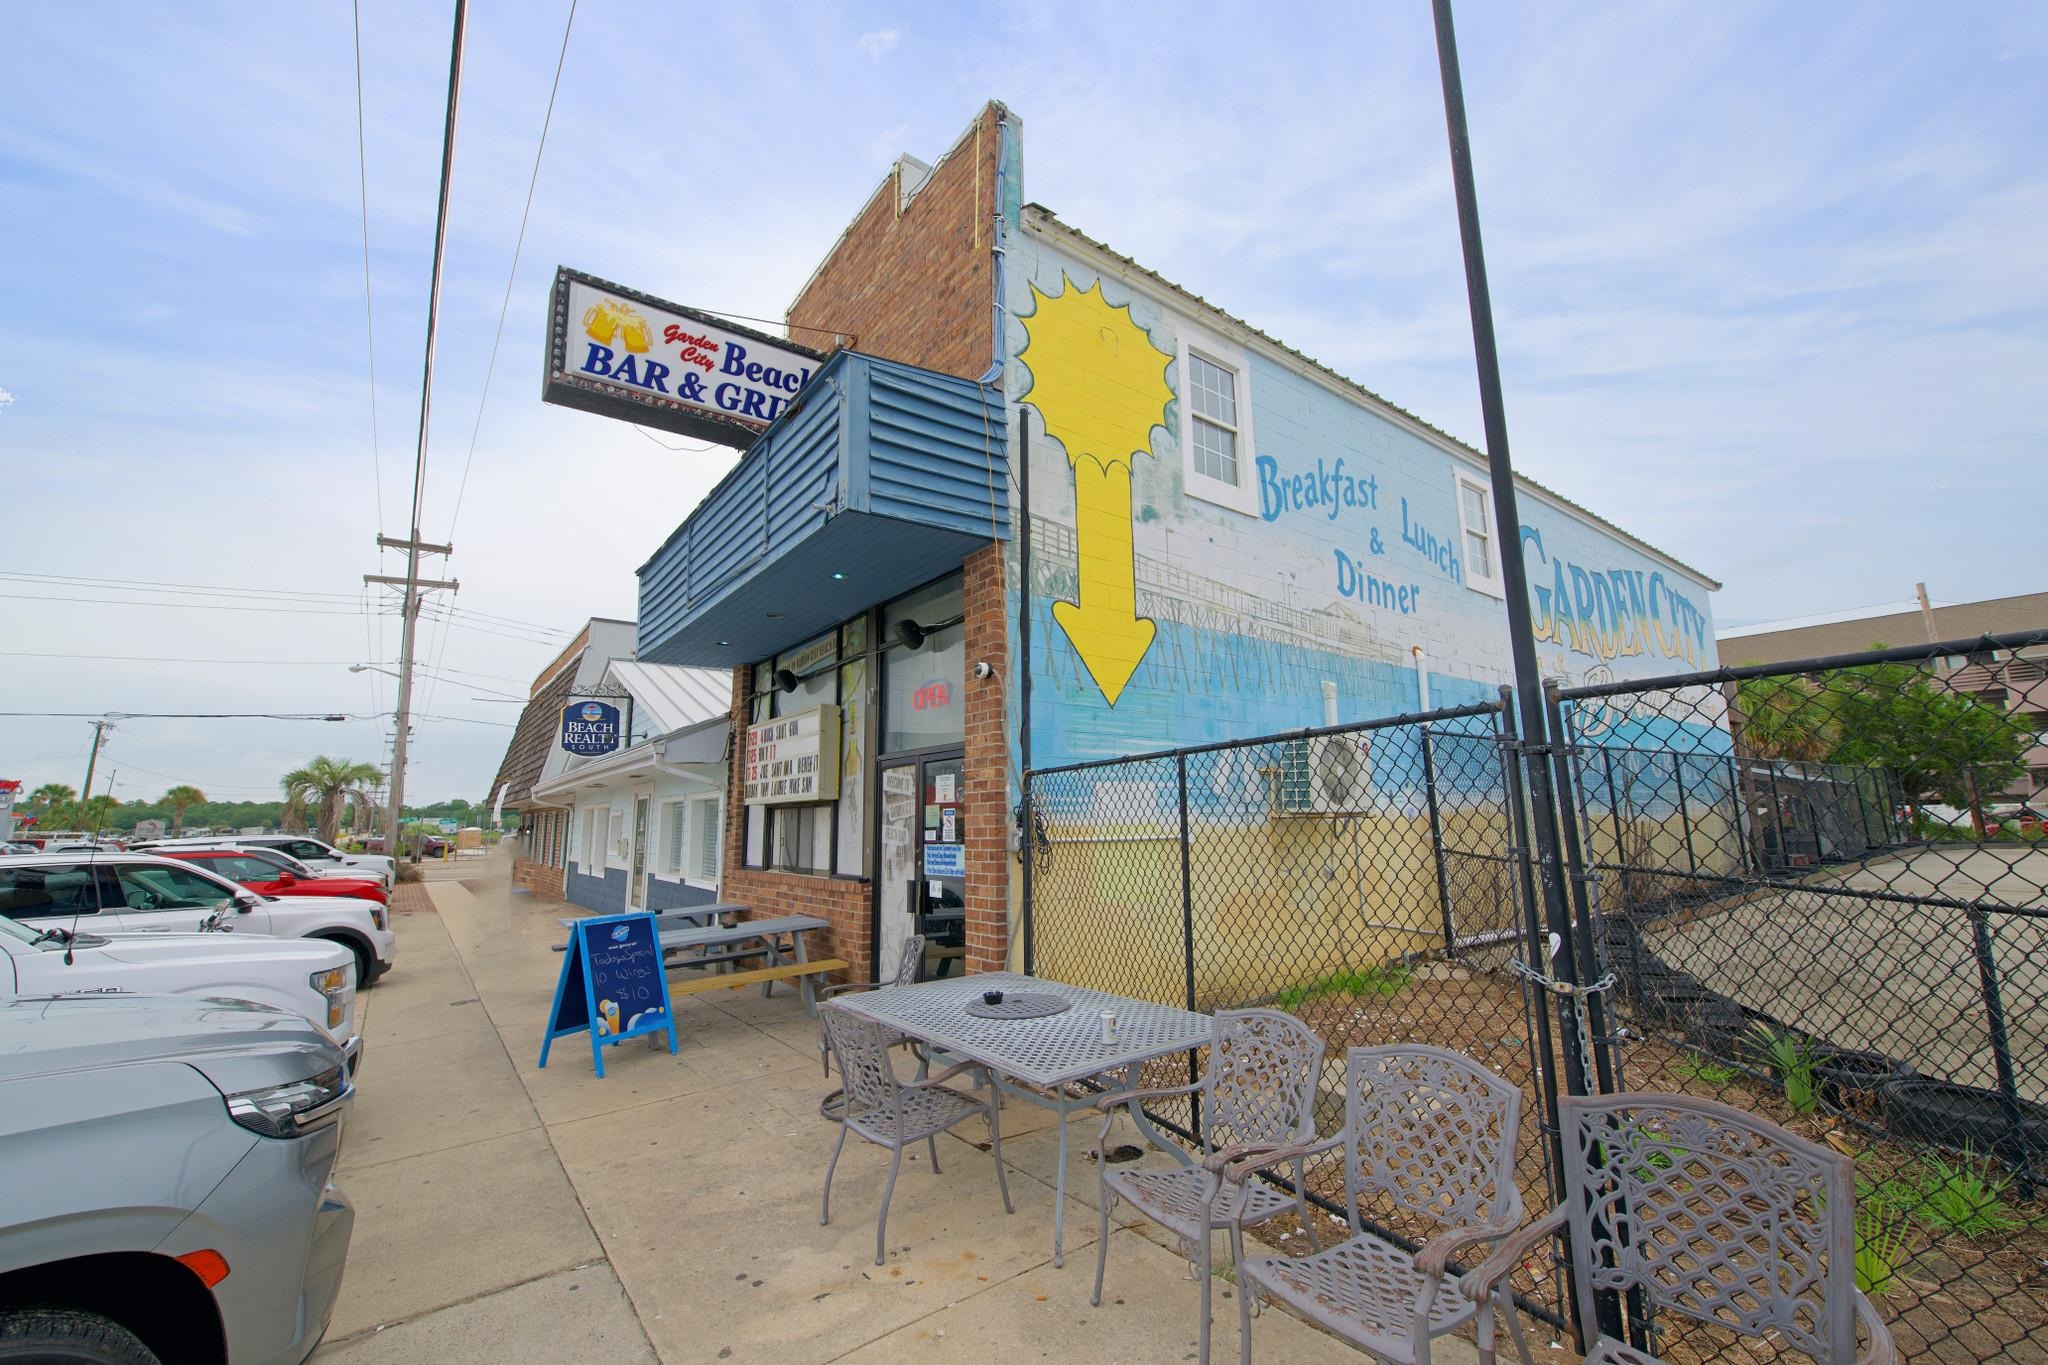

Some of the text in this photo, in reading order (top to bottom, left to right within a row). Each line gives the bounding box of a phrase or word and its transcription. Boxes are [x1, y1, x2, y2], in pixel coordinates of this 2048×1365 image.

[664, 324, 719, 352] Garden
[680, 347, 715, 372] City
[580, 342, 669, 393] BAR
[677, 372, 708, 403] &
[1255, 455, 1378, 522] Breakfast
[1370, 527, 1385, 555] &
[1402, 496, 1460, 585] Lunch
[1334, 548, 1419, 614] Dinner
[1650, 571, 1707, 672] CITY
[912, 683, 949, 711] OPEN
[568, 722, 613, 733] BEACH
